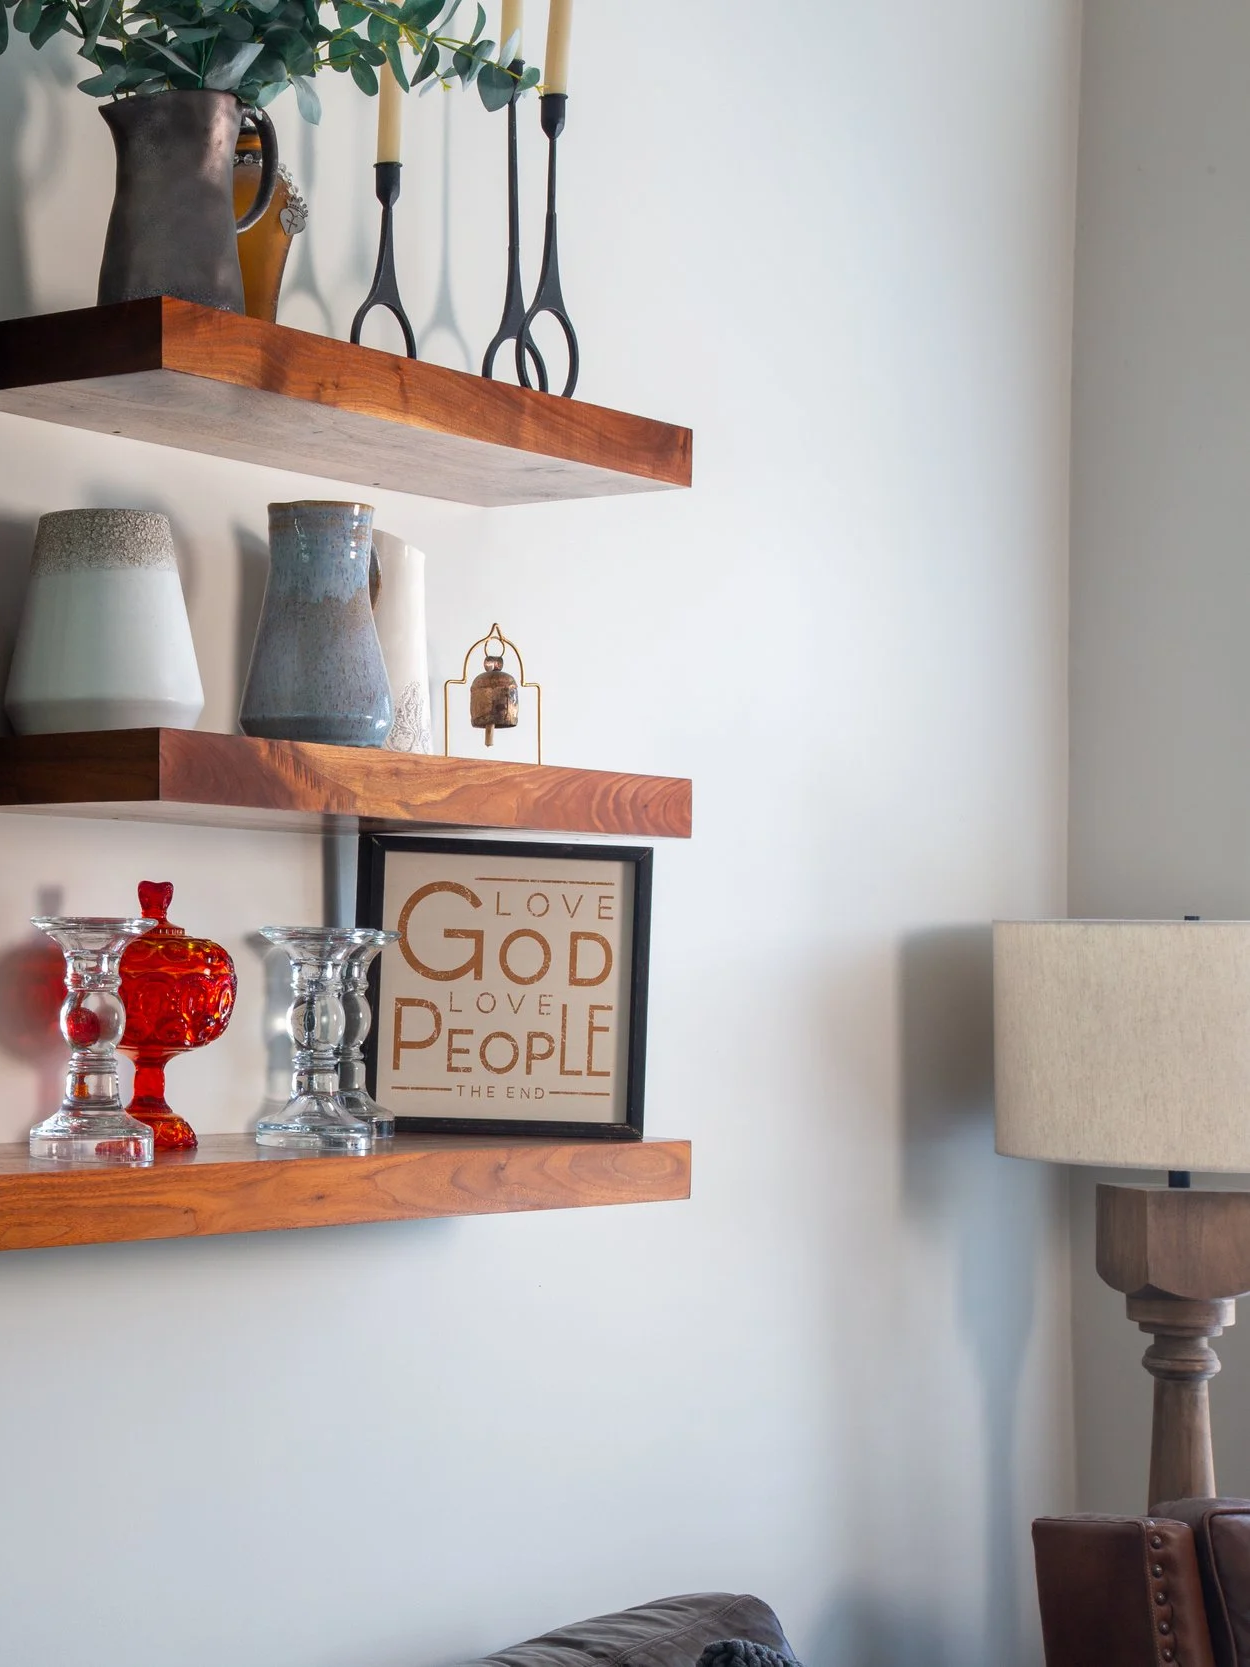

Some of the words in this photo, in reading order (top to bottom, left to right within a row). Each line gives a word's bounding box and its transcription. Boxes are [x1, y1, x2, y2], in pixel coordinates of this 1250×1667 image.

[496, 891, 614, 920] LOVE
[397, 880, 613, 986] GOD
[449, 991, 553, 1015] LOVE
[392, 997, 613, 1077] PEOPLE
[456, 1085, 495, 1098] THE
[506, 1086, 545, 1100] END
